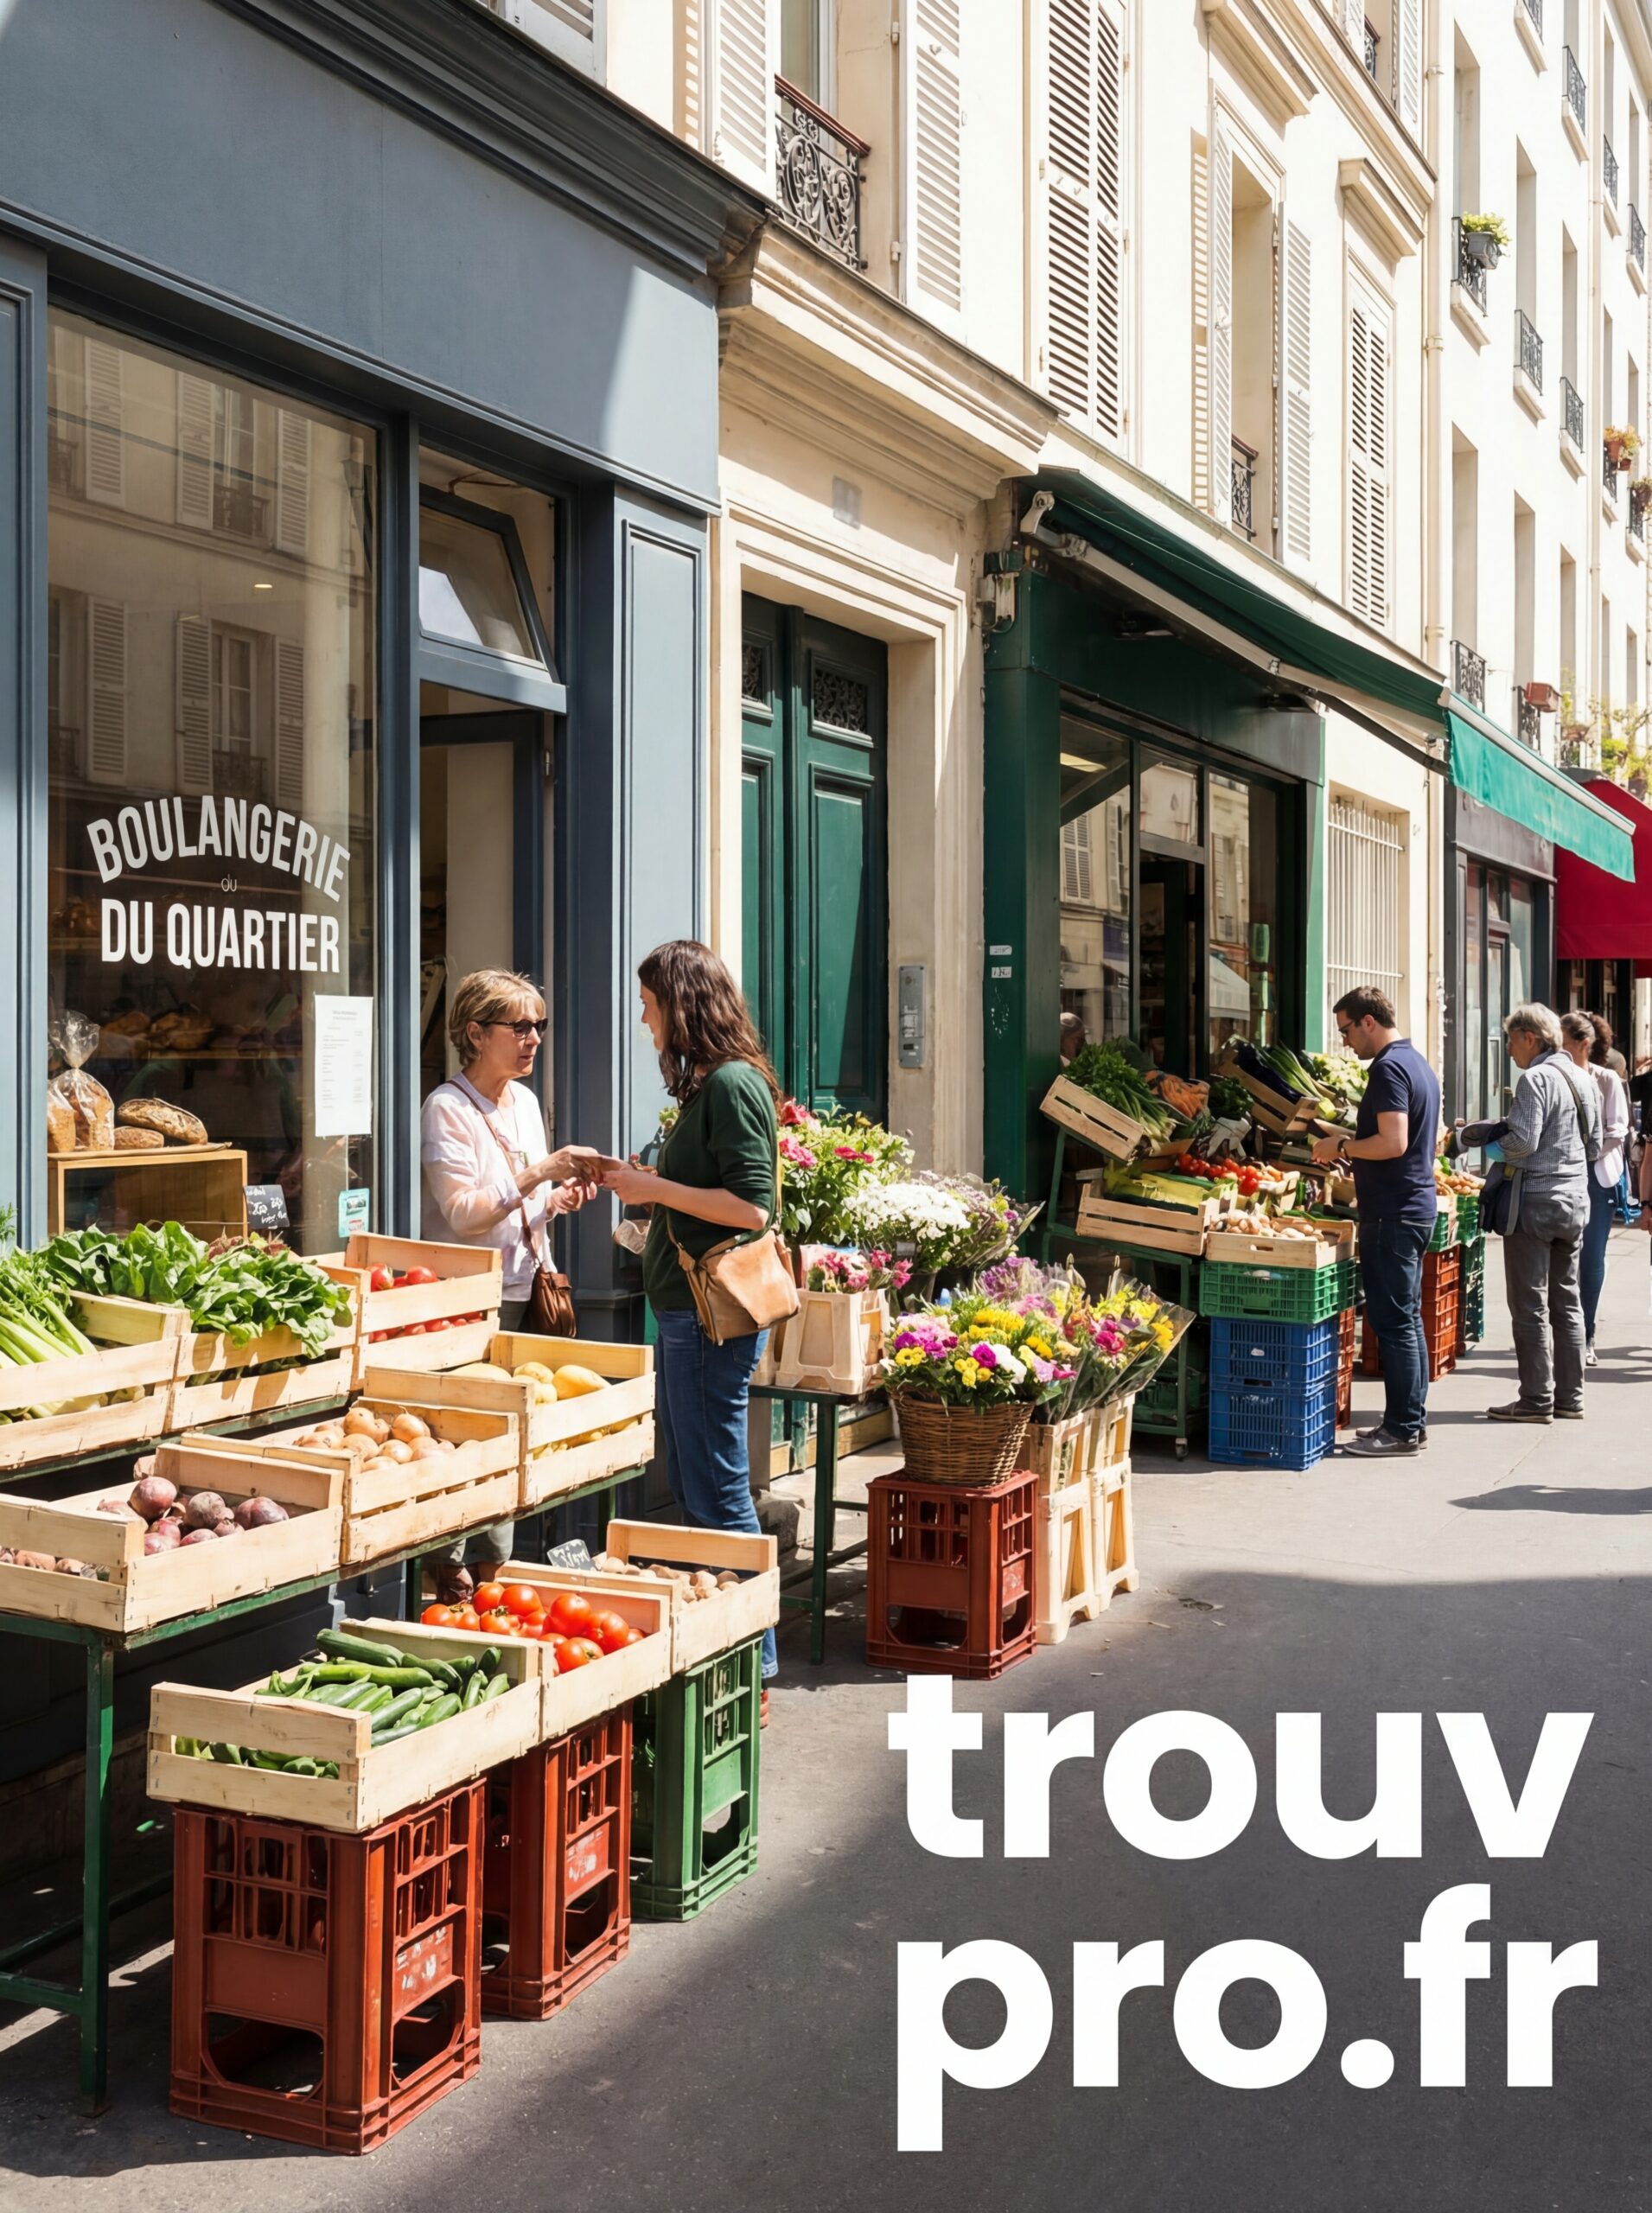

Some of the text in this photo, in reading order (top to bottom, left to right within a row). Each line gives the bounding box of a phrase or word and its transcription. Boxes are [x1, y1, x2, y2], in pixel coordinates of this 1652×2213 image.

[86, 795, 351, 902] BOULANGERIE
[101, 898, 340, 973] DU QUARTIER
